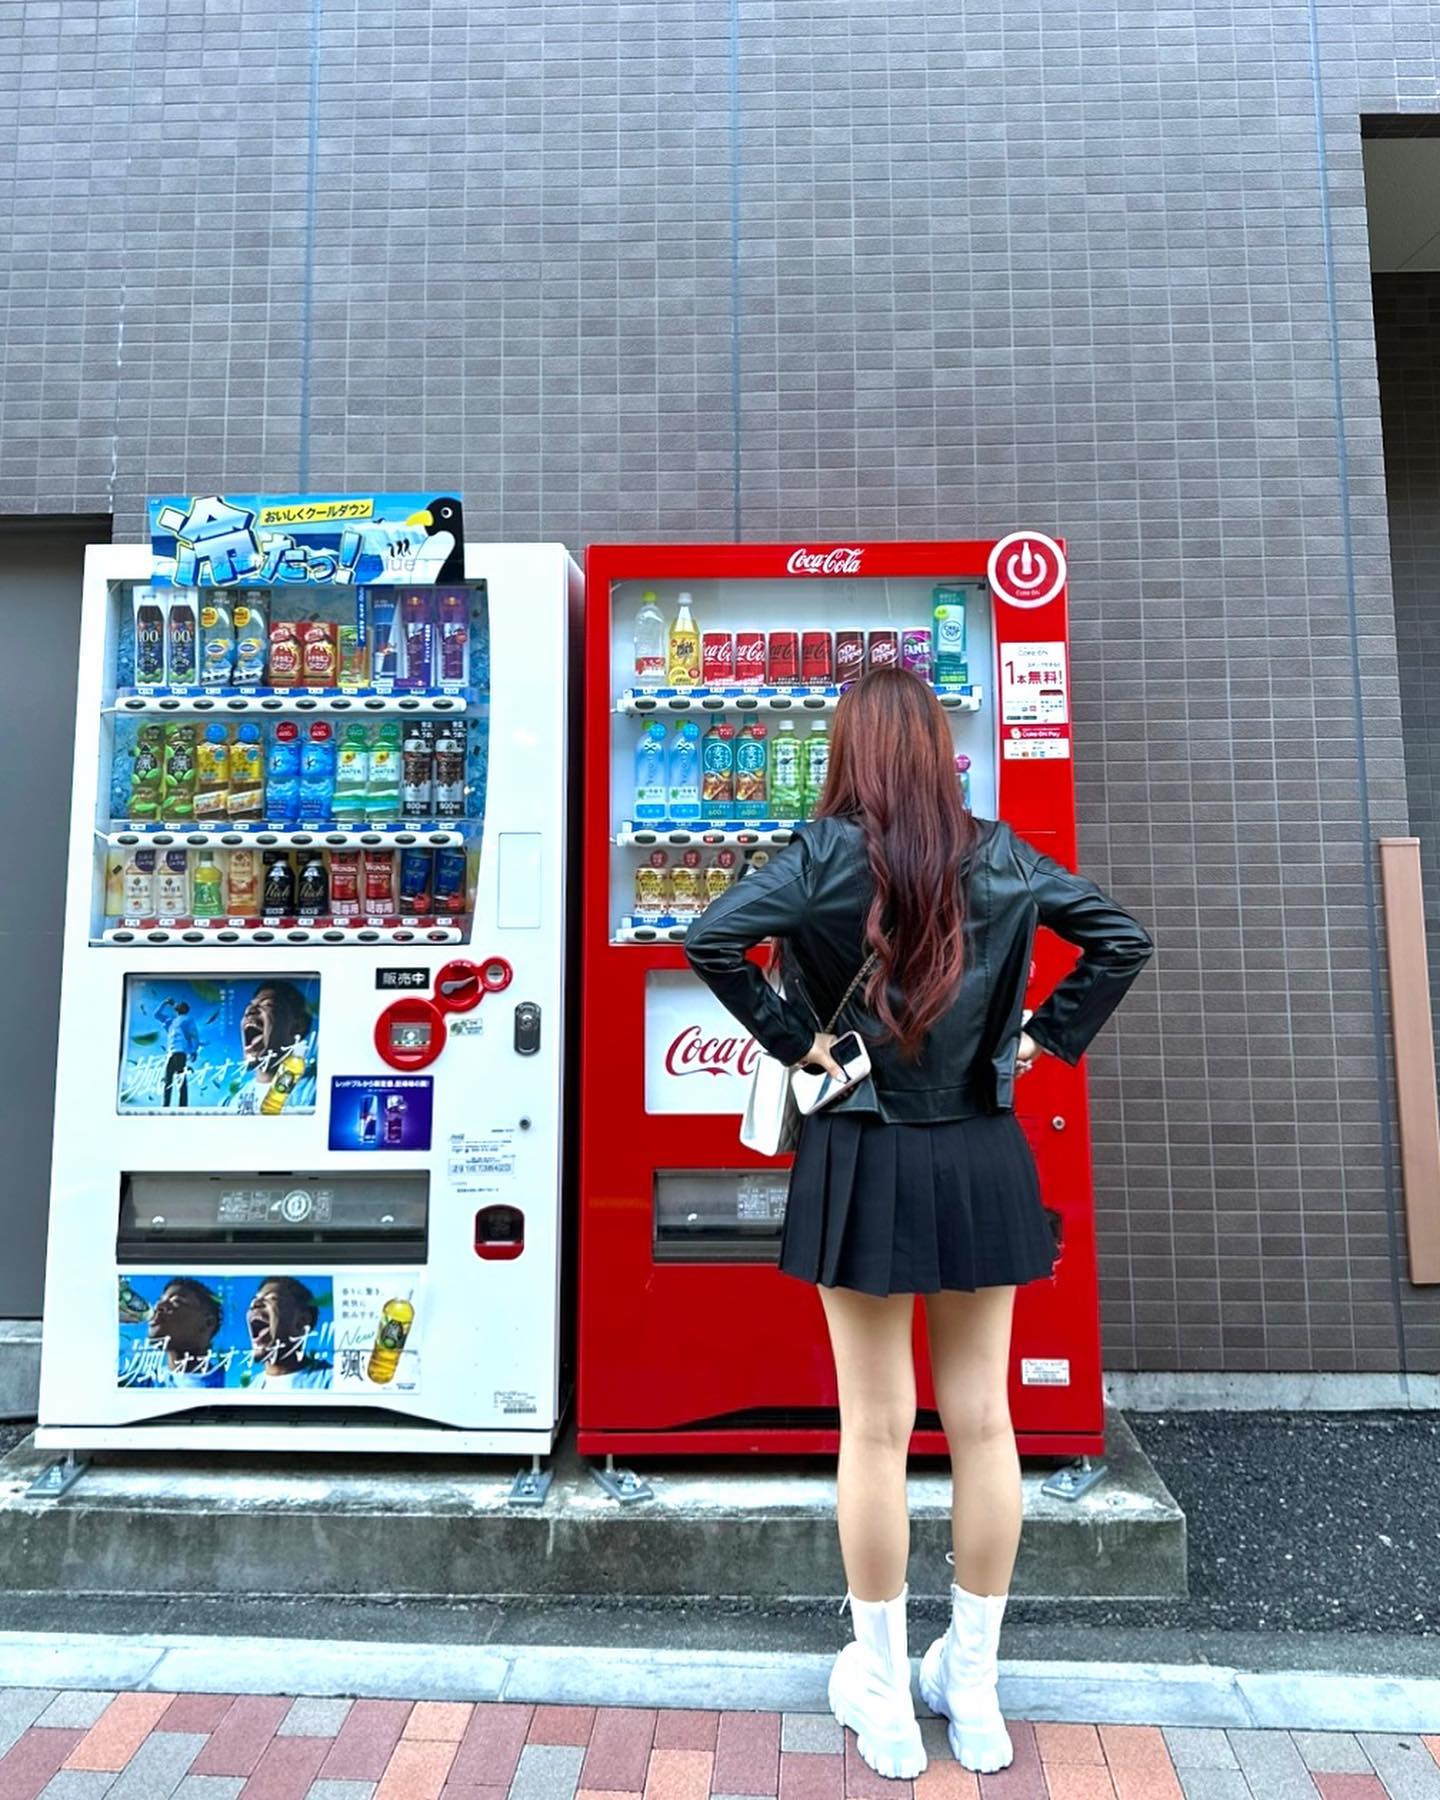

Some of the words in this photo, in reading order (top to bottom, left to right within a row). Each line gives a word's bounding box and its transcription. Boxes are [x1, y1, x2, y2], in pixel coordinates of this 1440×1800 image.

[264, 504, 371, 523] おいしくクールダウン
[158, 496, 358, 586] 冷たっ!
[787, 548, 864, 574] Coca-Cola
[1005, 660, 1064, 685] 1本無料!
[383, 972, 426, 986] 販売中
[339, 1326, 376, 1349] New
